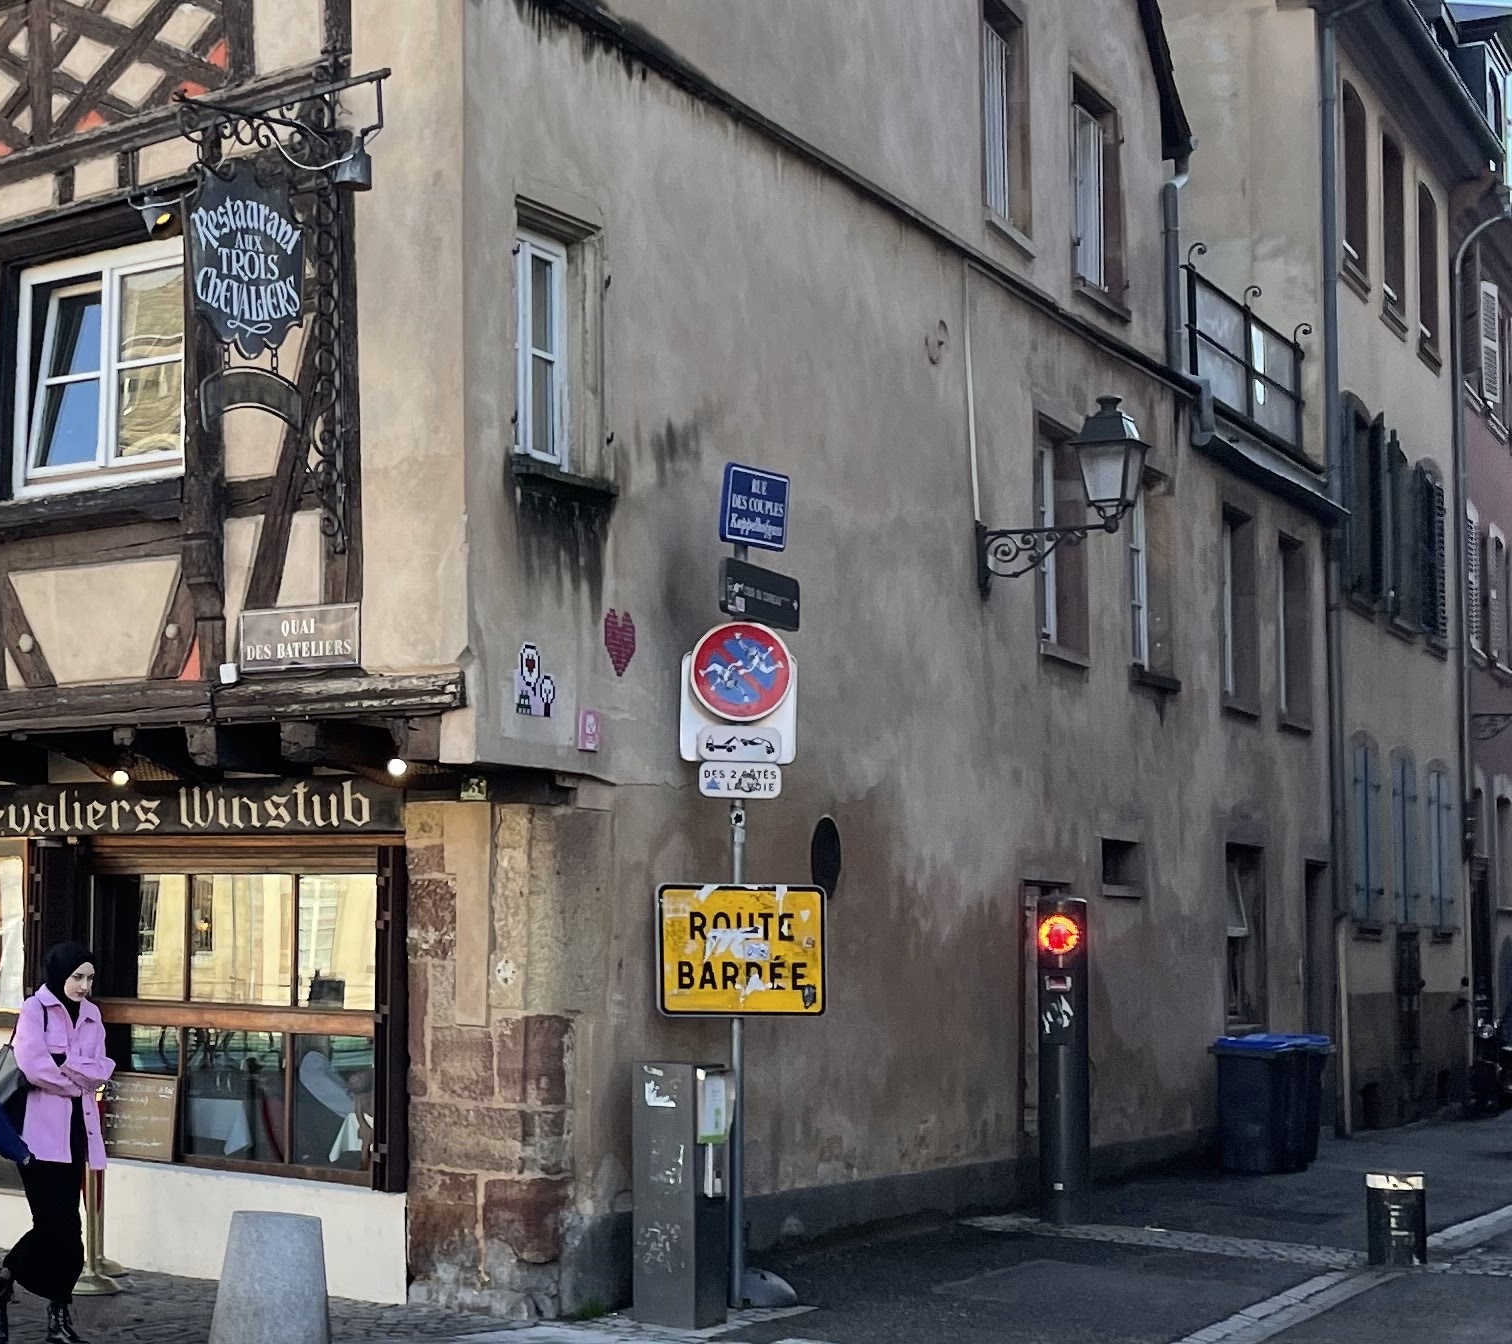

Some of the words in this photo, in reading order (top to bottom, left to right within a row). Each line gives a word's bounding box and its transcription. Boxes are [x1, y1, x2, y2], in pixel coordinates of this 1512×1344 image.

[190, 196, 302, 255] Restaurant
[217, 247, 280, 281] TROIS
[731, 493, 748, 510] DES
[748, 497, 784, 518] COUPLES
[281, 618, 316, 637] QUAI
[246, 644, 273, 661] DES
[276, 638, 353, 659] BATELIERS
[704, 769, 726, 779] DES
[730, 769, 737, 779] 2
[178, 779, 372, 829] Winstub
[689, 911, 794, 942] ROUTE
